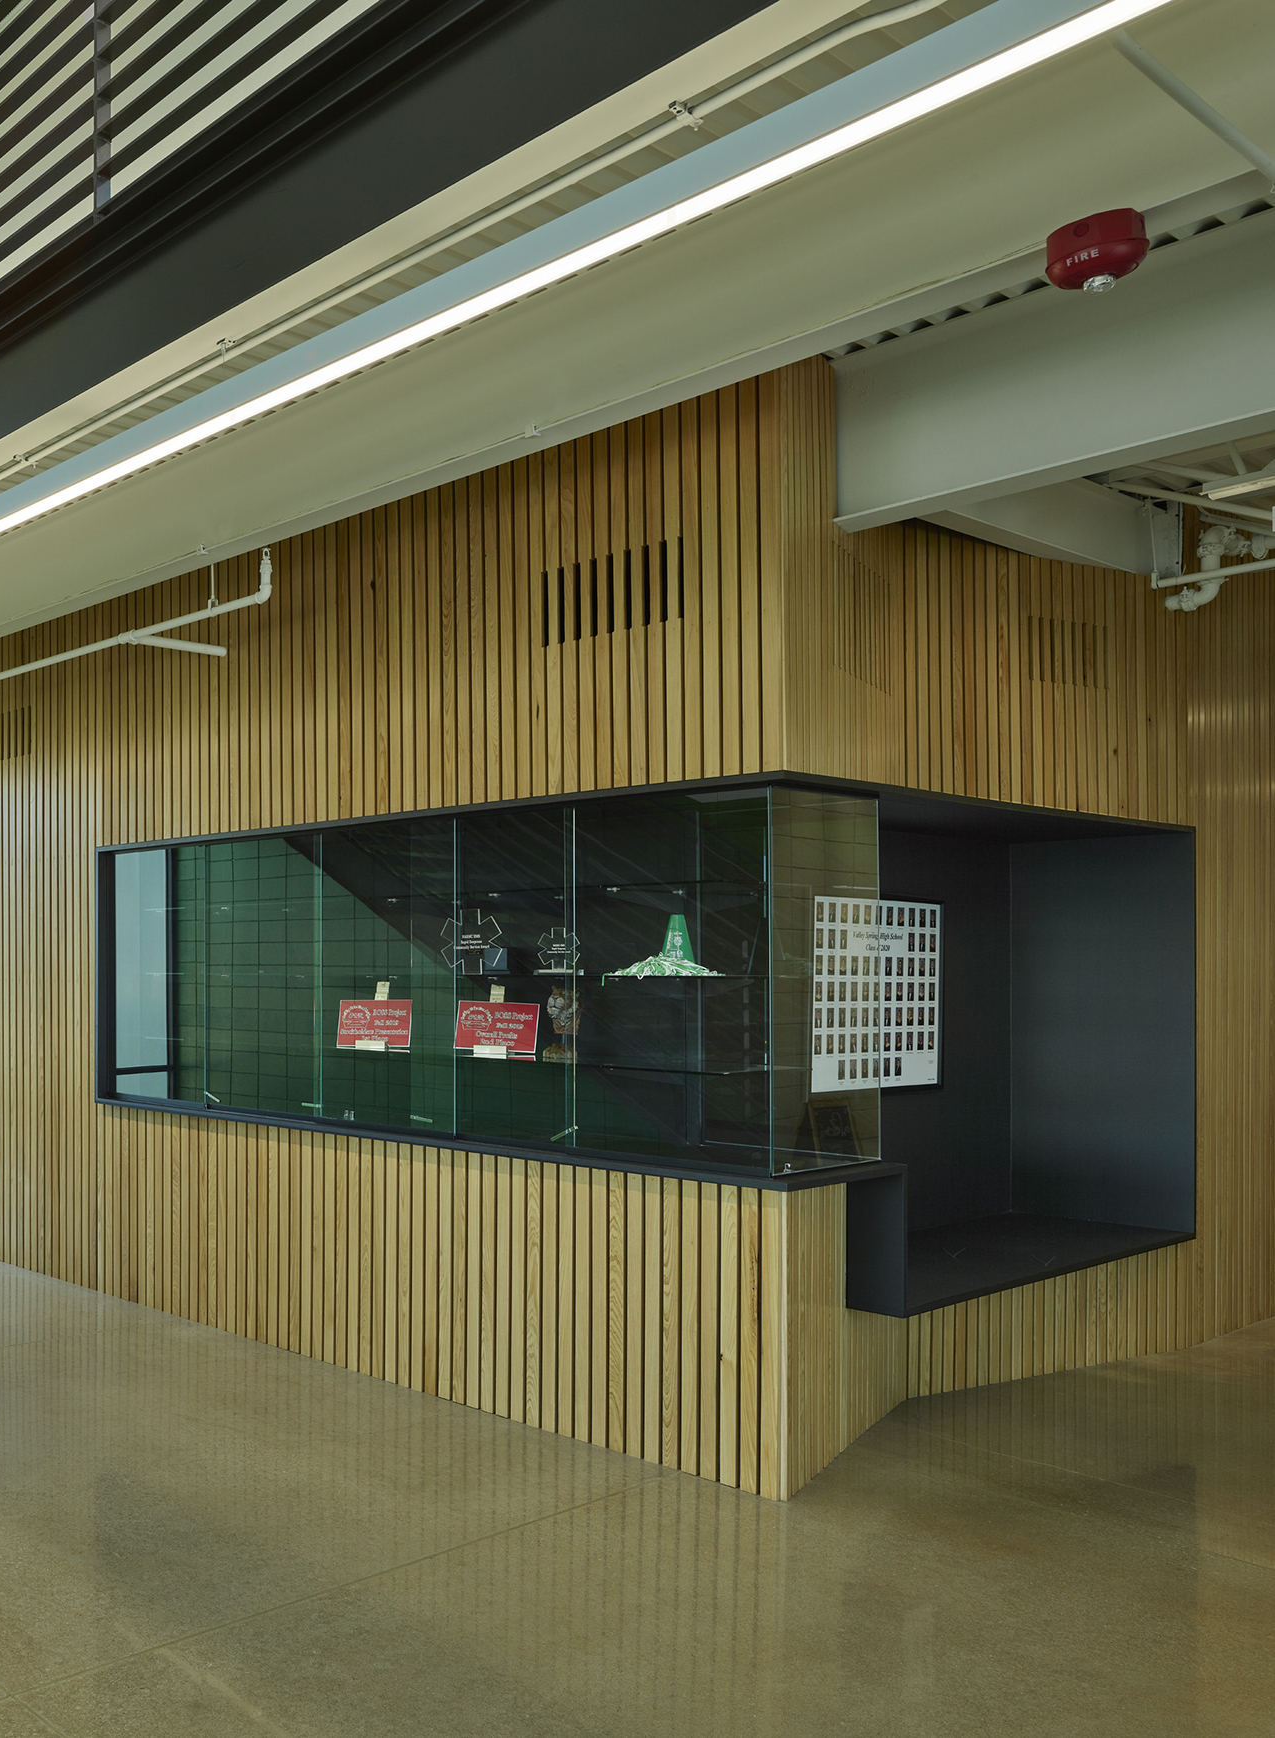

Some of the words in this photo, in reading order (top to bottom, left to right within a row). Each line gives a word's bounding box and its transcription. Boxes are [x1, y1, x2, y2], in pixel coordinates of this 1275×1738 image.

[1066, 248, 1100, 267] FIRE
[852, 931, 865, 940] Valley
[879, 932, 890, 941] High
[890, 932, 904, 940] School
[880, 944, 891, 952] 2020
[372, 1008, 388, 1016] BOSS
[388, 1009, 407, 1017] Project
[494, 1011, 511, 1019] BOSS
[512, 1011, 533, 1021] Project
[475, 1030, 497, 1038] Overall
[495, 1039, 515, 1047] Place
